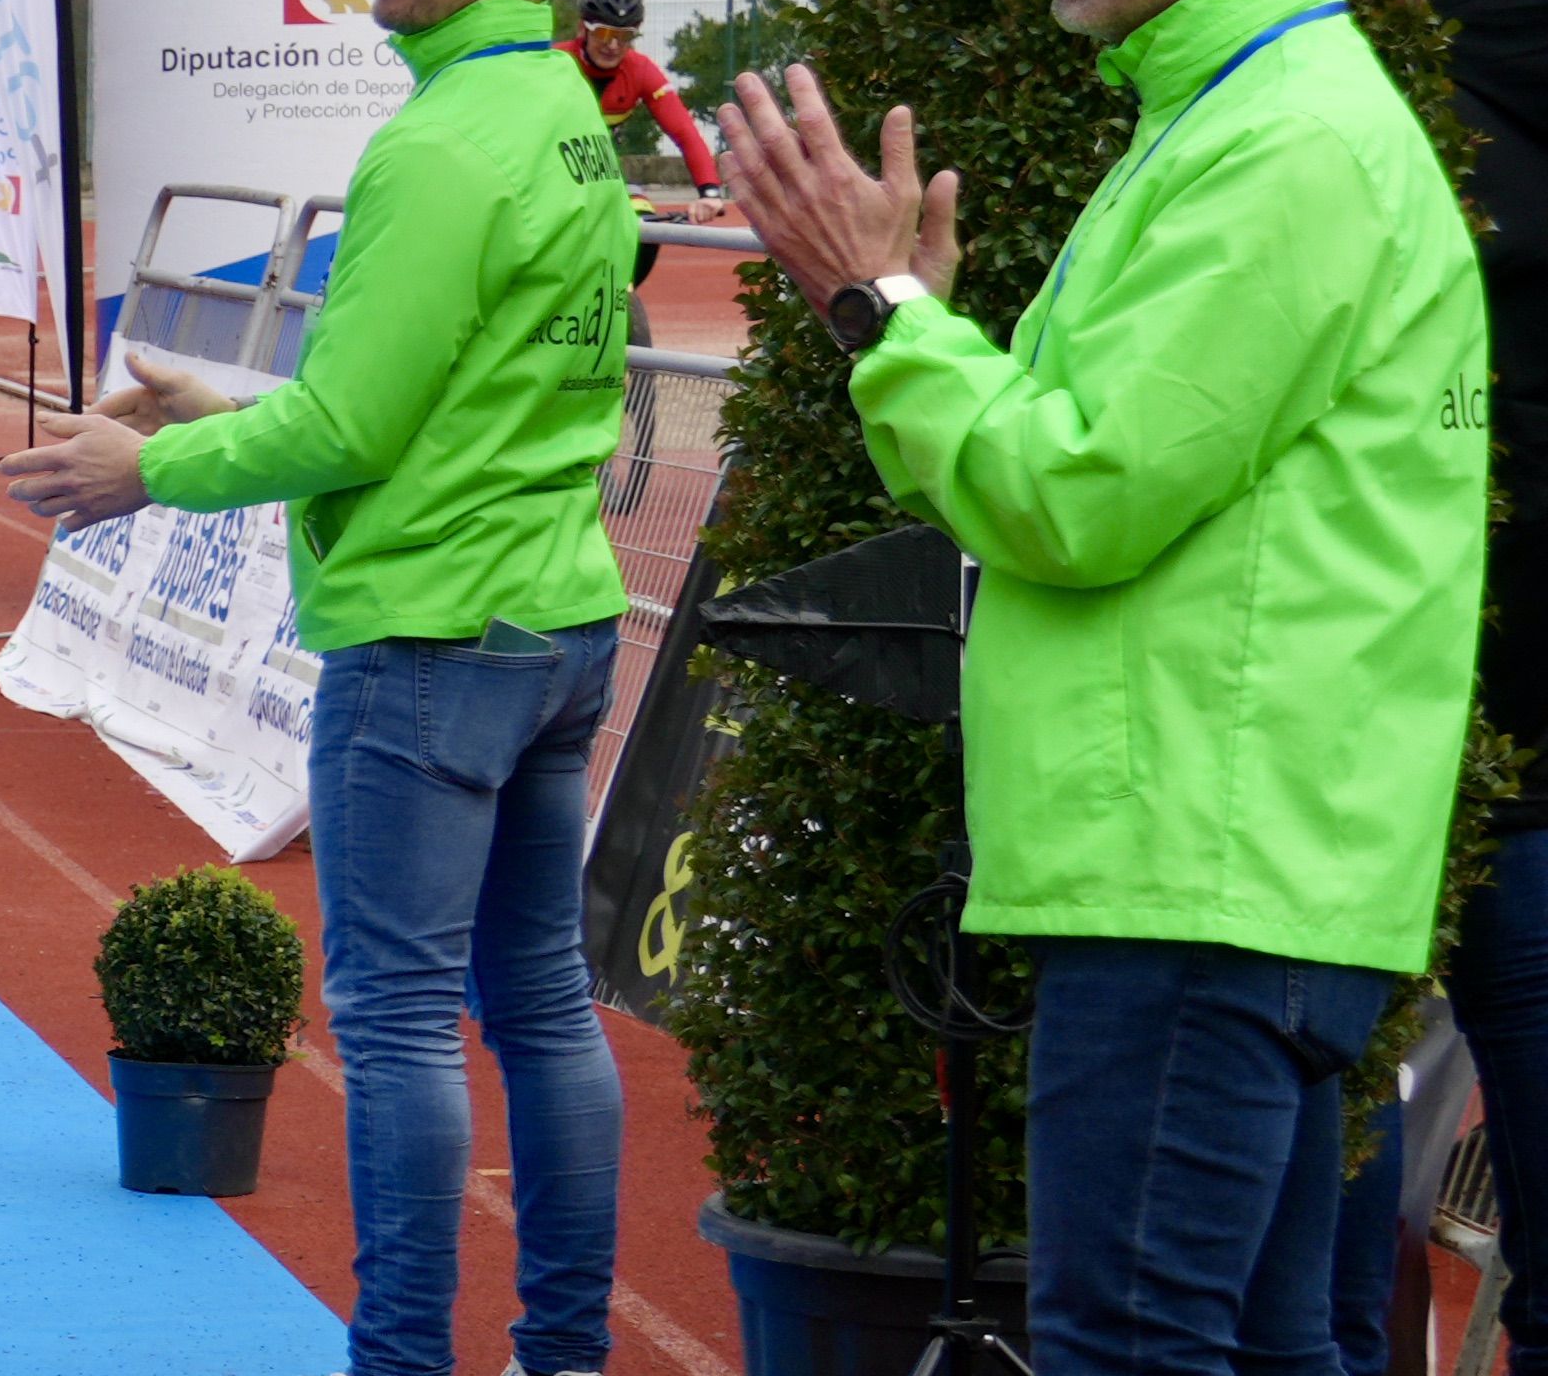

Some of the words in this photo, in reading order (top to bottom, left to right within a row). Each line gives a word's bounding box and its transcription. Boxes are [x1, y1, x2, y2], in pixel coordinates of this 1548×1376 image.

[161, 42, 319, 76] Diputación
[328, 42, 364, 66] de
[213, 80, 319, 100] Delegación
[325, 80, 350, 95] de
[245, 106, 256, 124] y
[263, 102, 361, 119] Protección
